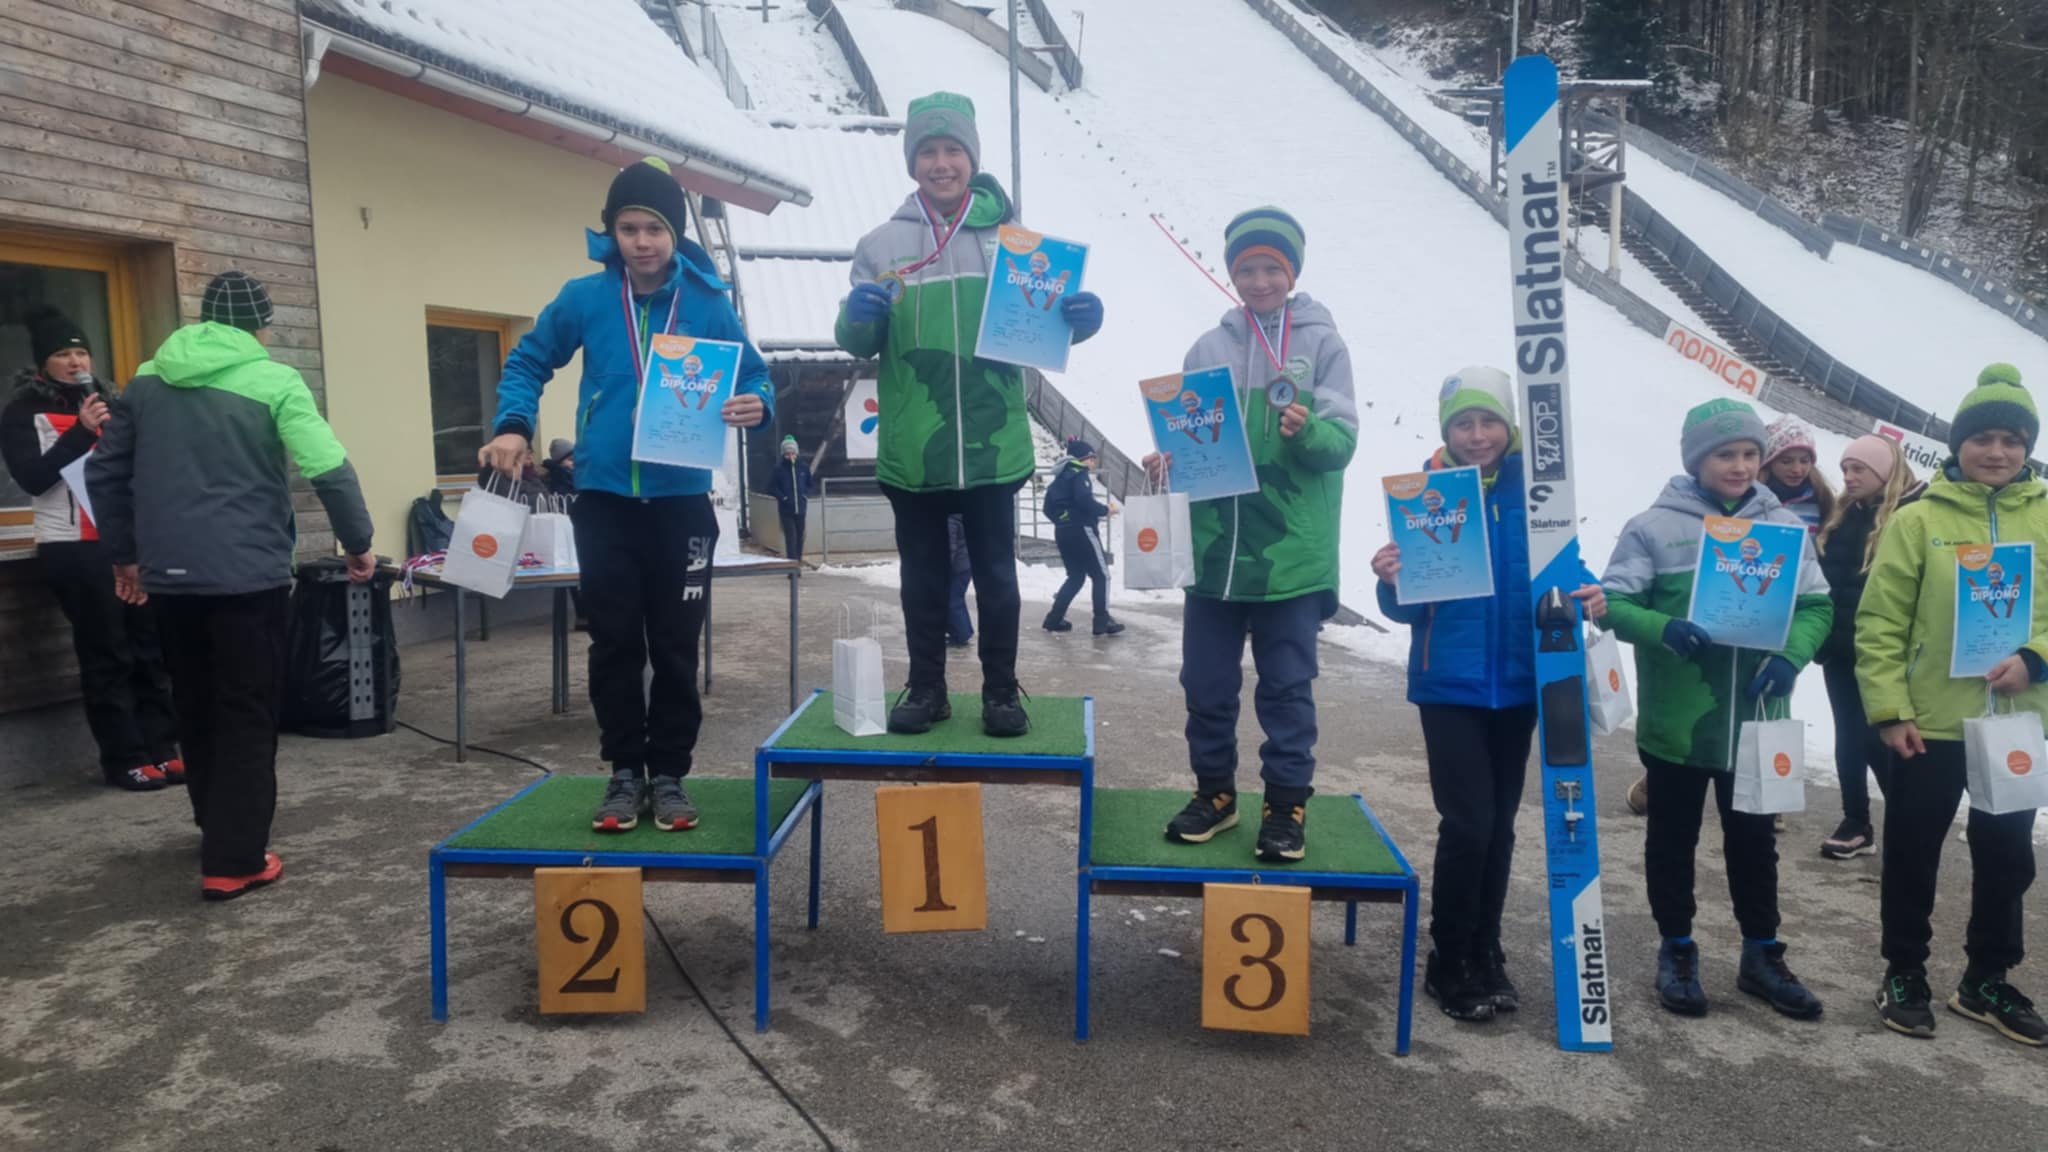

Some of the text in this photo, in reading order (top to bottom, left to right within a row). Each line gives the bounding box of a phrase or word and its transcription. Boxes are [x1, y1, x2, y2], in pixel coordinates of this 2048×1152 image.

[1007, 272, 1065, 295] DIPLOMO
[1515, 172, 1566, 375] Slatnar
[660, 377, 718, 393] DIPLOMO
[1167, 411, 1225, 432] DIPLOMO
[1405, 511, 1468, 531] DIPLOMO
[1530, 518, 1572, 529] Slatnar
[1715, 560, 1781, 579] DIPLOMO
[1970, 587, 2020, 602] DIPLOMO
[907, 816, 957, 914] 1
[558, 898, 622, 995] 2
[1222, 912, 1288, 1013] 3
[1580, 923, 1608, 1025] Slatnar
